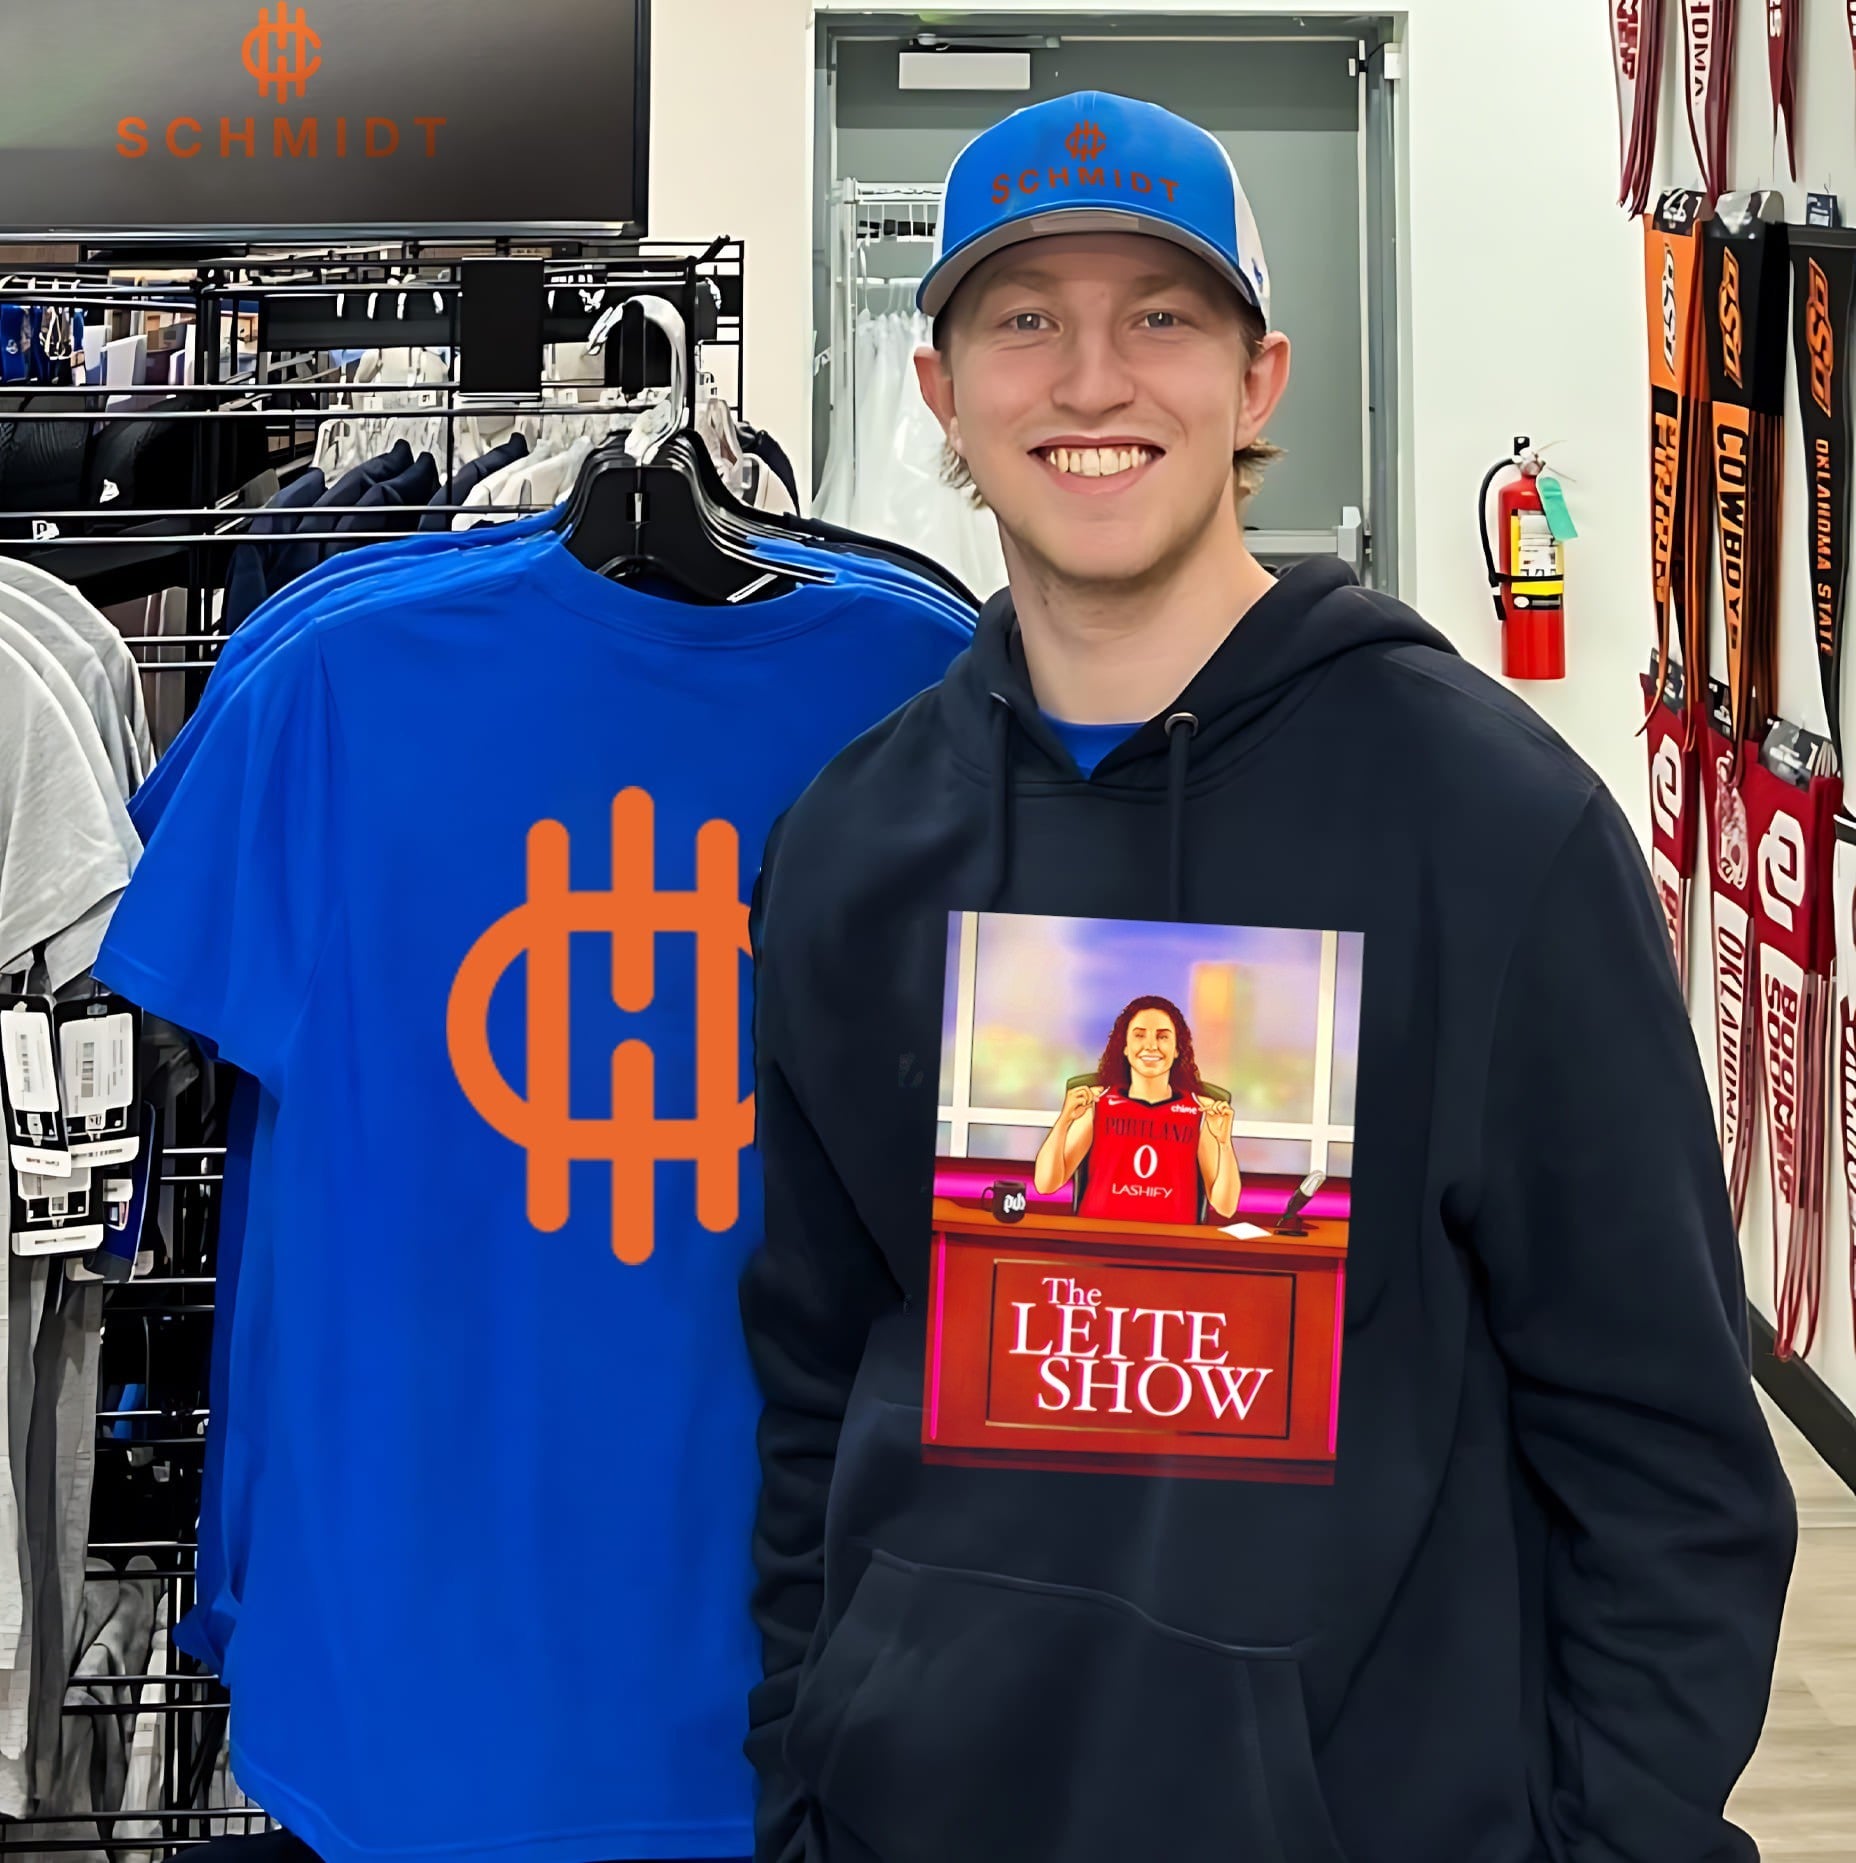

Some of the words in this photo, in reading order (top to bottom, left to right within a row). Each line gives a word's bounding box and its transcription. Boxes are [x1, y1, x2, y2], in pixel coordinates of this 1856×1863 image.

[115, 116, 448, 159] SCHMIDT
[991, 166, 1180, 205] SCHMIDT
[1815, 438, 1832, 570] OKLAHOMA
[1817, 582, 1834, 657] STATE
[1718, 925, 1745, 1144] OKLAHOMA
[1104, 1116, 1194, 1144] PORTLAND
[1171, 1104, 1198, 1115] chime
[1112, 1182, 1173, 1199] LASHIFY
[1042, 1277, 1102, 1307] The
[1008, 1301, 1229, 1365] LEITE
[1036, 1357, 1274, 1421] SHOW
